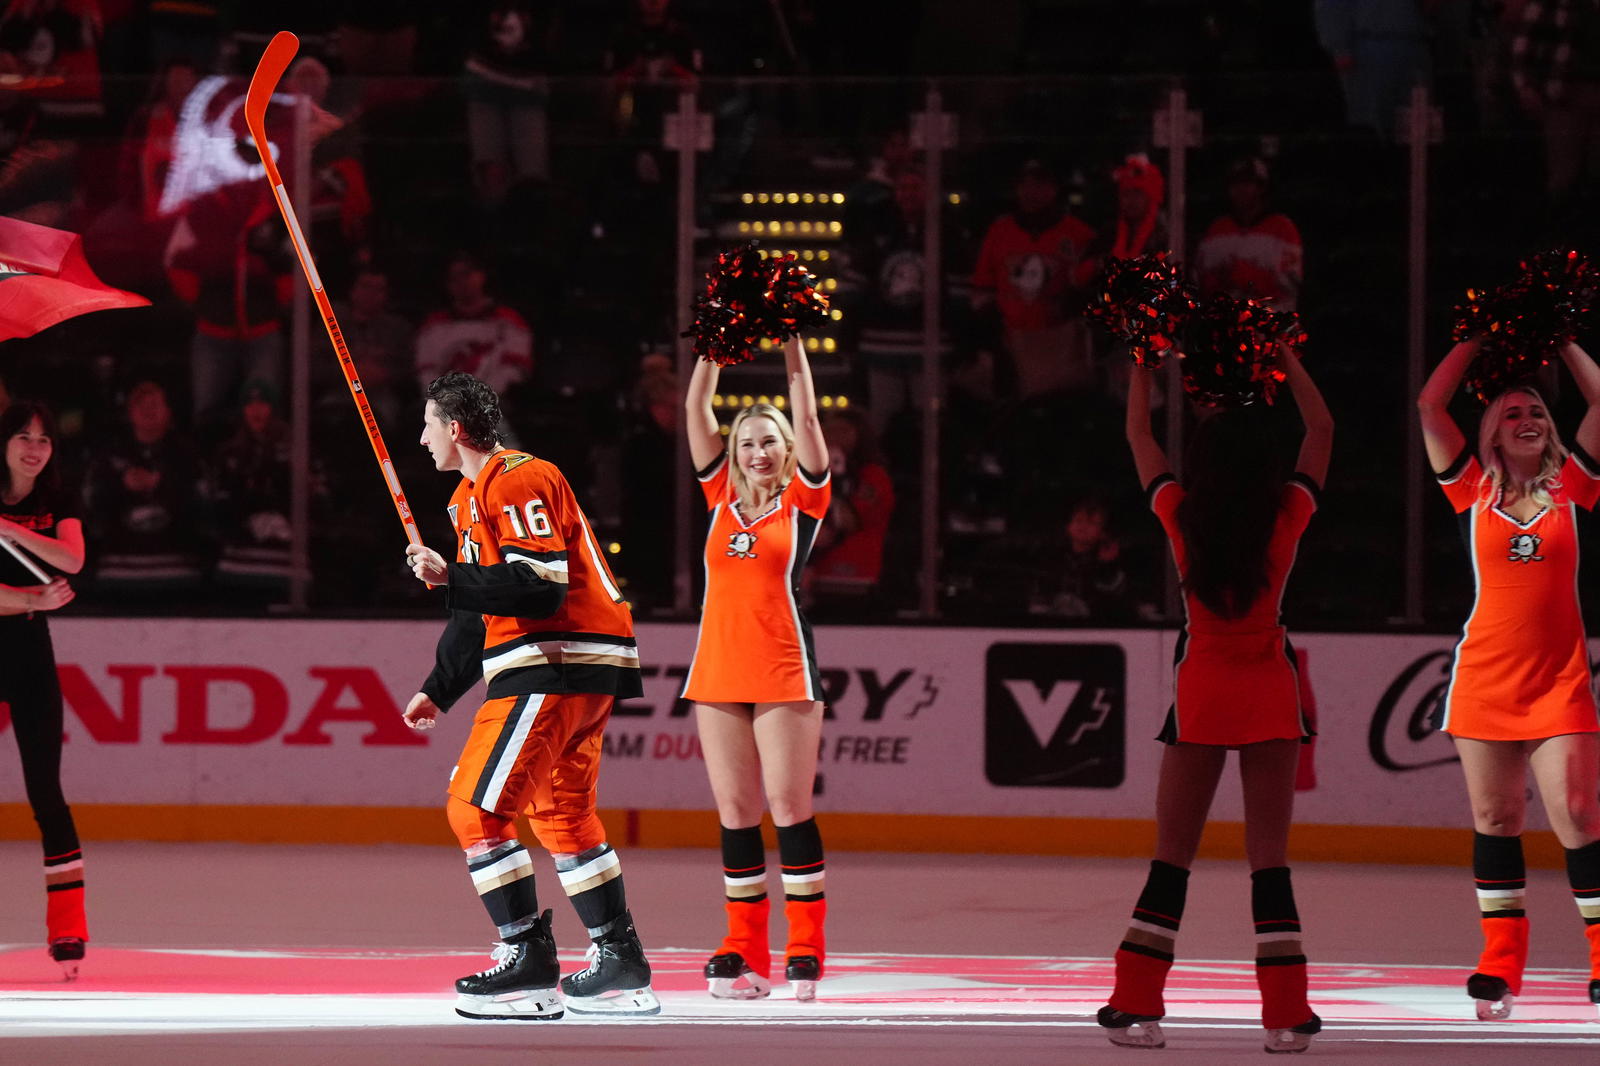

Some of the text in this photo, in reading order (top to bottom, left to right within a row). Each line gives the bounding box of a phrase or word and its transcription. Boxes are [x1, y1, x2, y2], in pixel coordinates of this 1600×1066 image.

[328, 317, 380, 439] ANAHEIM DUCKS
[470, 496, 480, 524] A
[503, 499, 554, 539] 16
[0, 664, 429, 747] NDA
[833, 735, 911, 764] FREE
